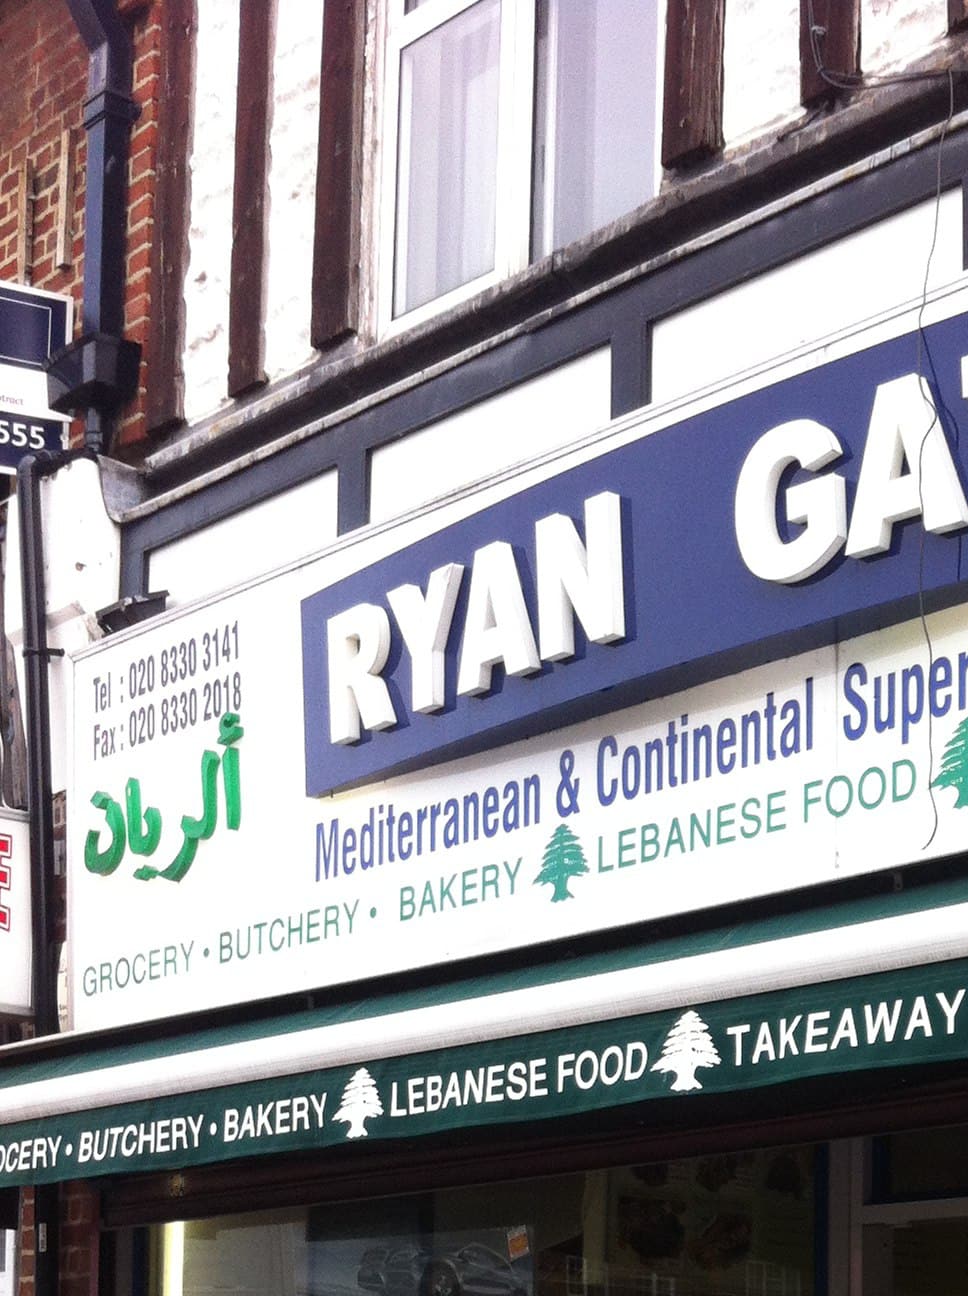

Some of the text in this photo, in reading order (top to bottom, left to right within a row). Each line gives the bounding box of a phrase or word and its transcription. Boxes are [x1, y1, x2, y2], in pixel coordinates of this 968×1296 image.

[93, 671, 112, 713] Tel
[129, 654, 155, 699] 020
[160, 637, 197, 687] 8330
[202, 620, 239, 671] 3141
[326, 490, 632, 746] RYAN
[94, 723, 116, 760] Fax
[129, 703, 155, 747] 020
[161, 687, 198, 736] 8330
[203, 671, 242, 721] 2018
[314, 770, 541, 883] Mediterranean
[555, 749, 582, 818] &
[596, 676, 814, 808] Continental
[82, 939, 195, 997] GROCERY
[218, 898, 360, 964] BUTCHERY
[399, 857, 523, 921] BAKERY
[597, 789, 787, 873] LEBANESE
[802, 758, 917, 823] FOOD
[77, 1114, 204, 1163] BUTCHERY
[223, 1092, 328, 1143] BAKERY
[389, 1058, 549, 1118] LEBANESE
[556, 1041, 649, 1093] FOOD
[725, 989, 967, 1068] TAKEAWAY
